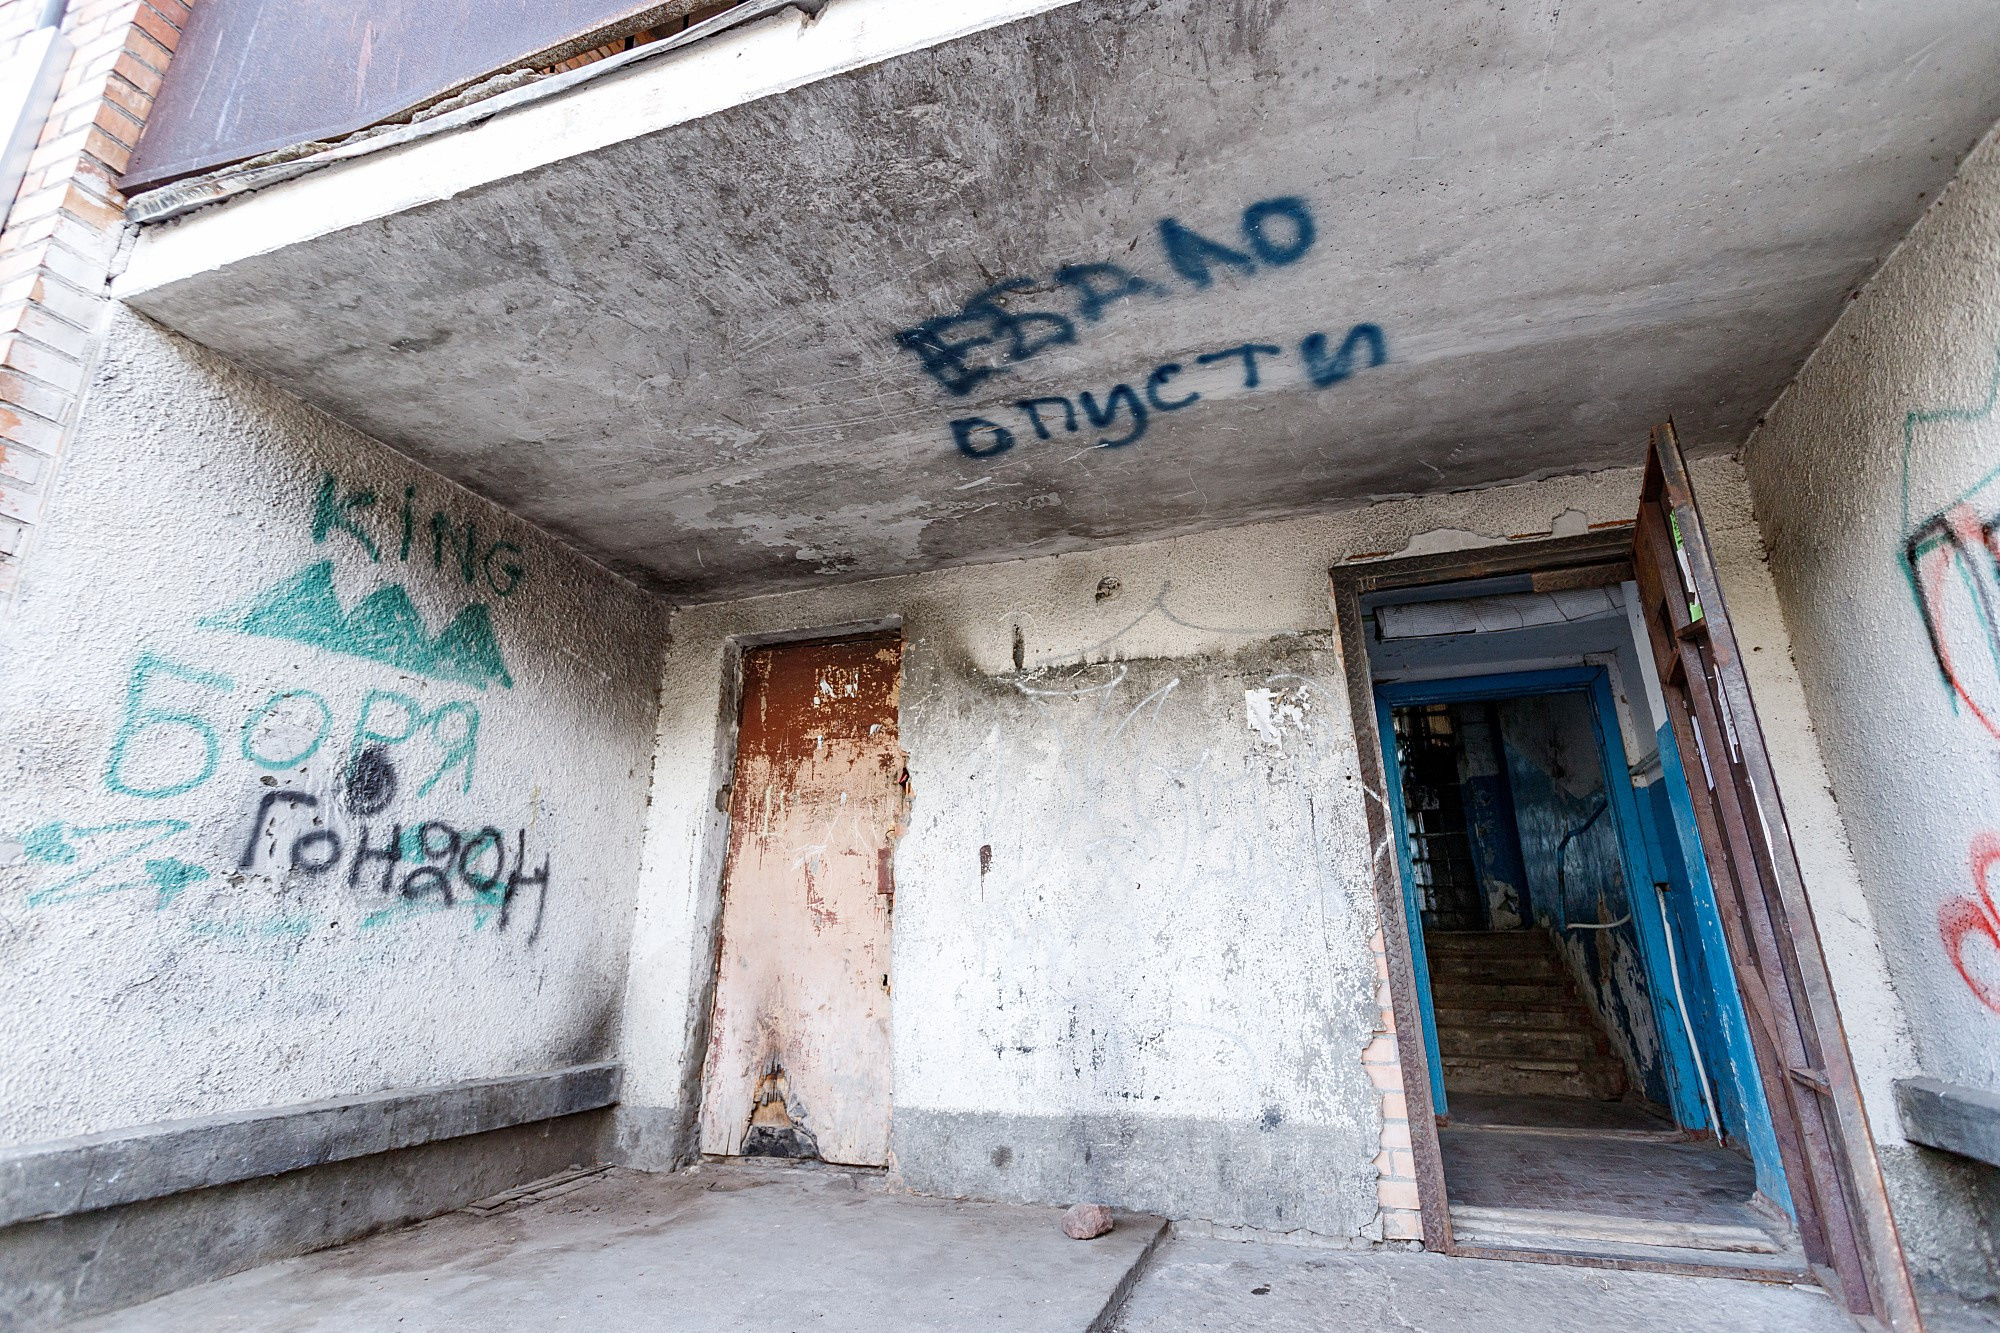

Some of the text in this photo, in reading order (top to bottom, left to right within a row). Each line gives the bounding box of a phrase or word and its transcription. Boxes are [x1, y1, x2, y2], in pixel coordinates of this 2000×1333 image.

[949, 323, 1386, 458] ОПУСТИ
[311, 471, 523, 596] KING
[104, 651, 480, 799] БОРЯ
